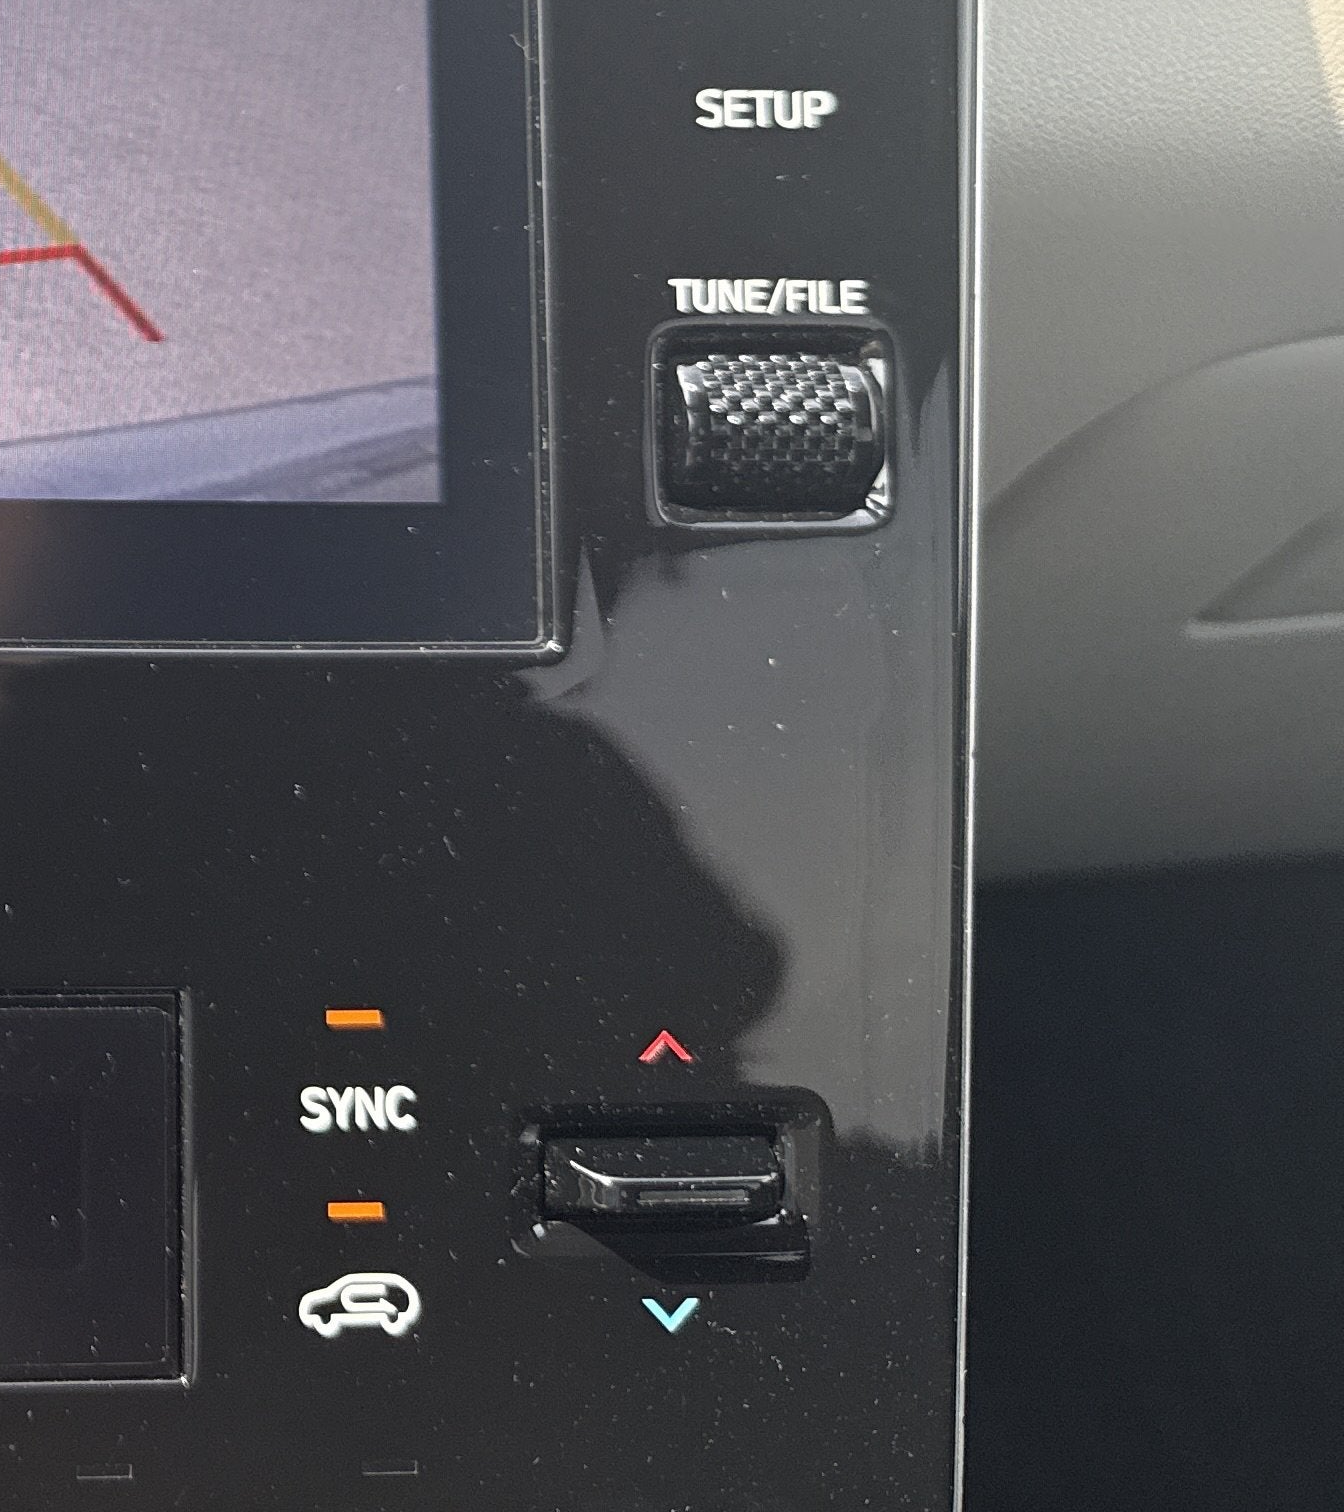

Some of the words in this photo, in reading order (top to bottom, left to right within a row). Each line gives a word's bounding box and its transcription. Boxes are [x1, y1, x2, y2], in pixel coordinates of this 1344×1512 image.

[695, 89, 838, 130] SETUP
[667, 277, 870, 315] TUNE/FILE
[299, 1084, 418, 1133] SYNC
